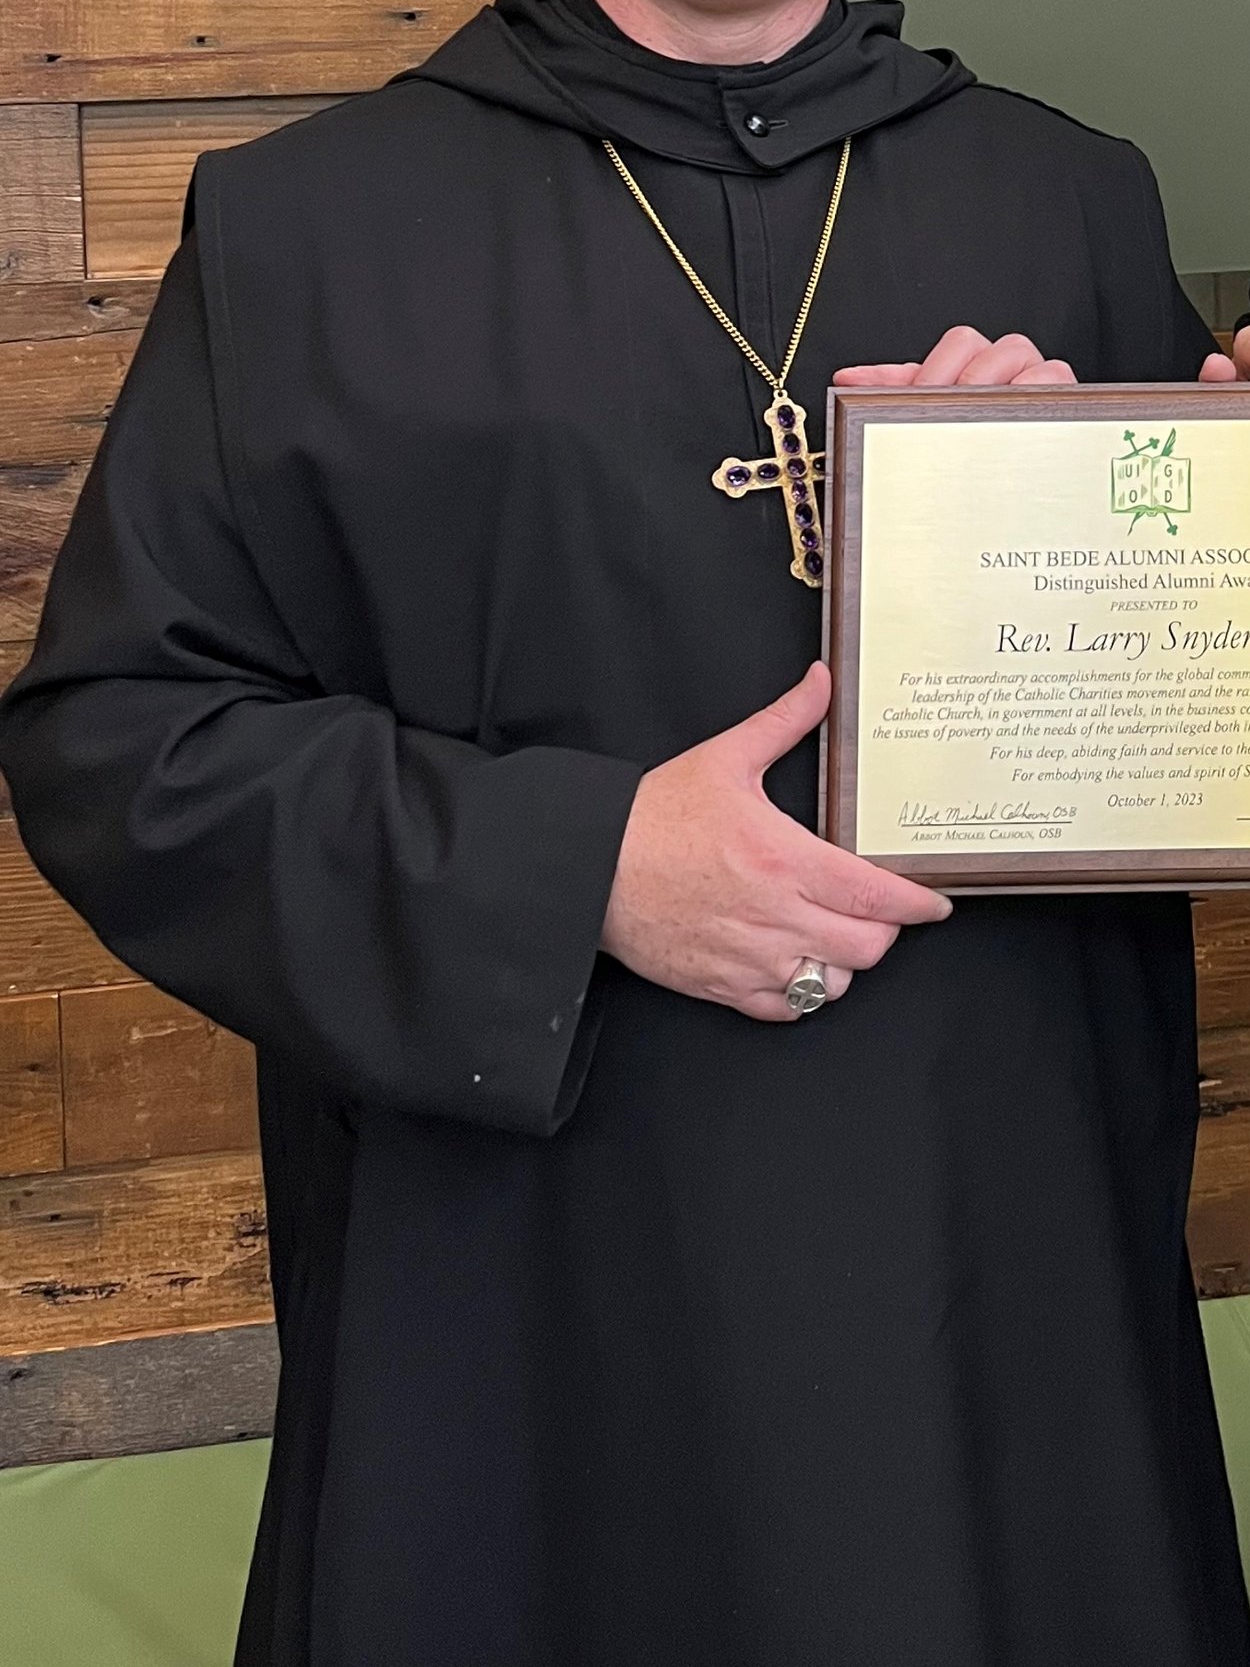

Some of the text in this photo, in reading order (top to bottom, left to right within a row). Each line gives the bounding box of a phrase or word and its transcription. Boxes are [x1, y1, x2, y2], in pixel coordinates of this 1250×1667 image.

[1164, 464, 1173, 478] G
[1129, 490, 1138, 504] O
[1165, 490, 1173, 504] D
[980, 551, 1041, 568] SAINT
[1046, 550, 1100, 567] BEDE
[1104, 548, 1185, 566] ALUMNI
[1033, 572, 1148, 595] Distinguished
[1152, 572, 1214, 589] Alumni
[1109, 599, 1198, 612] PRESENTED TO
[994, 623, 1051, 653] Rev.
[1063, 622, 1151, 661] Larry
[899, 672, 923, 686] For
[924, 671, 943, 685] his
[945, 670, 1028, 688] extraordinary
[1029, 668, 1132, 687] accomplishments
[1131, 668, 1153, 685] for
[1155, 667, 1174, 681] the
[1175, 667, 1215, 685] global
[911, 688, 975, 706] leadership
[977, 688, 993, 706] of
[992, 687, 1012, 702] the
[1014, 686, 1066, 702] Catholic
[1068, 686, 1123, 701] Charities
[1125, 687, 1186, 700] movement
[1188, 684, 1213, 698] and
[1214, 684, 1233, 698] the
[882, 707, 934, 722] Catholic
[937, 705, 984, 721] Church,
[987, 707, 1000, 720] in
[1001, 706, 1073, 723] government
[1075, 706, 1088, 718] at
[1090, 703, 1108, 718] all
[1109, 703, 1147, 718] levels,
[1150, 703, 1162, 717] in
[1164, 702, 1184, 717] the
[1186, 702, 1236, 716] business
[872, 725, 891, 739] the
[893, 727, 930, 739] issues
[932, 724, 948, 742] of
[946, 726, 993, 742] poverty
[995, 722, 1020, 737] and
[1021, 722, 1041, 737] the
[1042, 722, 1077, 736] needs
[1079, 721, 1095, 739] of
[1095, 721, 1114, 736] the
[1116, 719, 1212, 738] underprivileged
[1213, 719, 1240, 733] both
[989, 745, 1013, 760] For
[1015, 745, 1033, 759] his
[1035, 744, 1068, 762] deep,
[1071, 743, 1118, 761] abiding
[1116, 743, 1147, 761] faith
[1149, 742, 1174, 757] and
[1175, 743, 1218, 756] service
[1220, 743, 1233, 756] to
[1011, 767, 1035, 782] For
[1037, 766, 1103, 785] embodying
[1105, 766, 1124, 780] the
[1127, 765, 1165, 780] values
[1167, 764, 1193, 779] and
[1193, 765, 1226, 782] spirit
[1228, 764, 1244, 782] of
[1105, 791, 1203, 808] October 1, 2023
